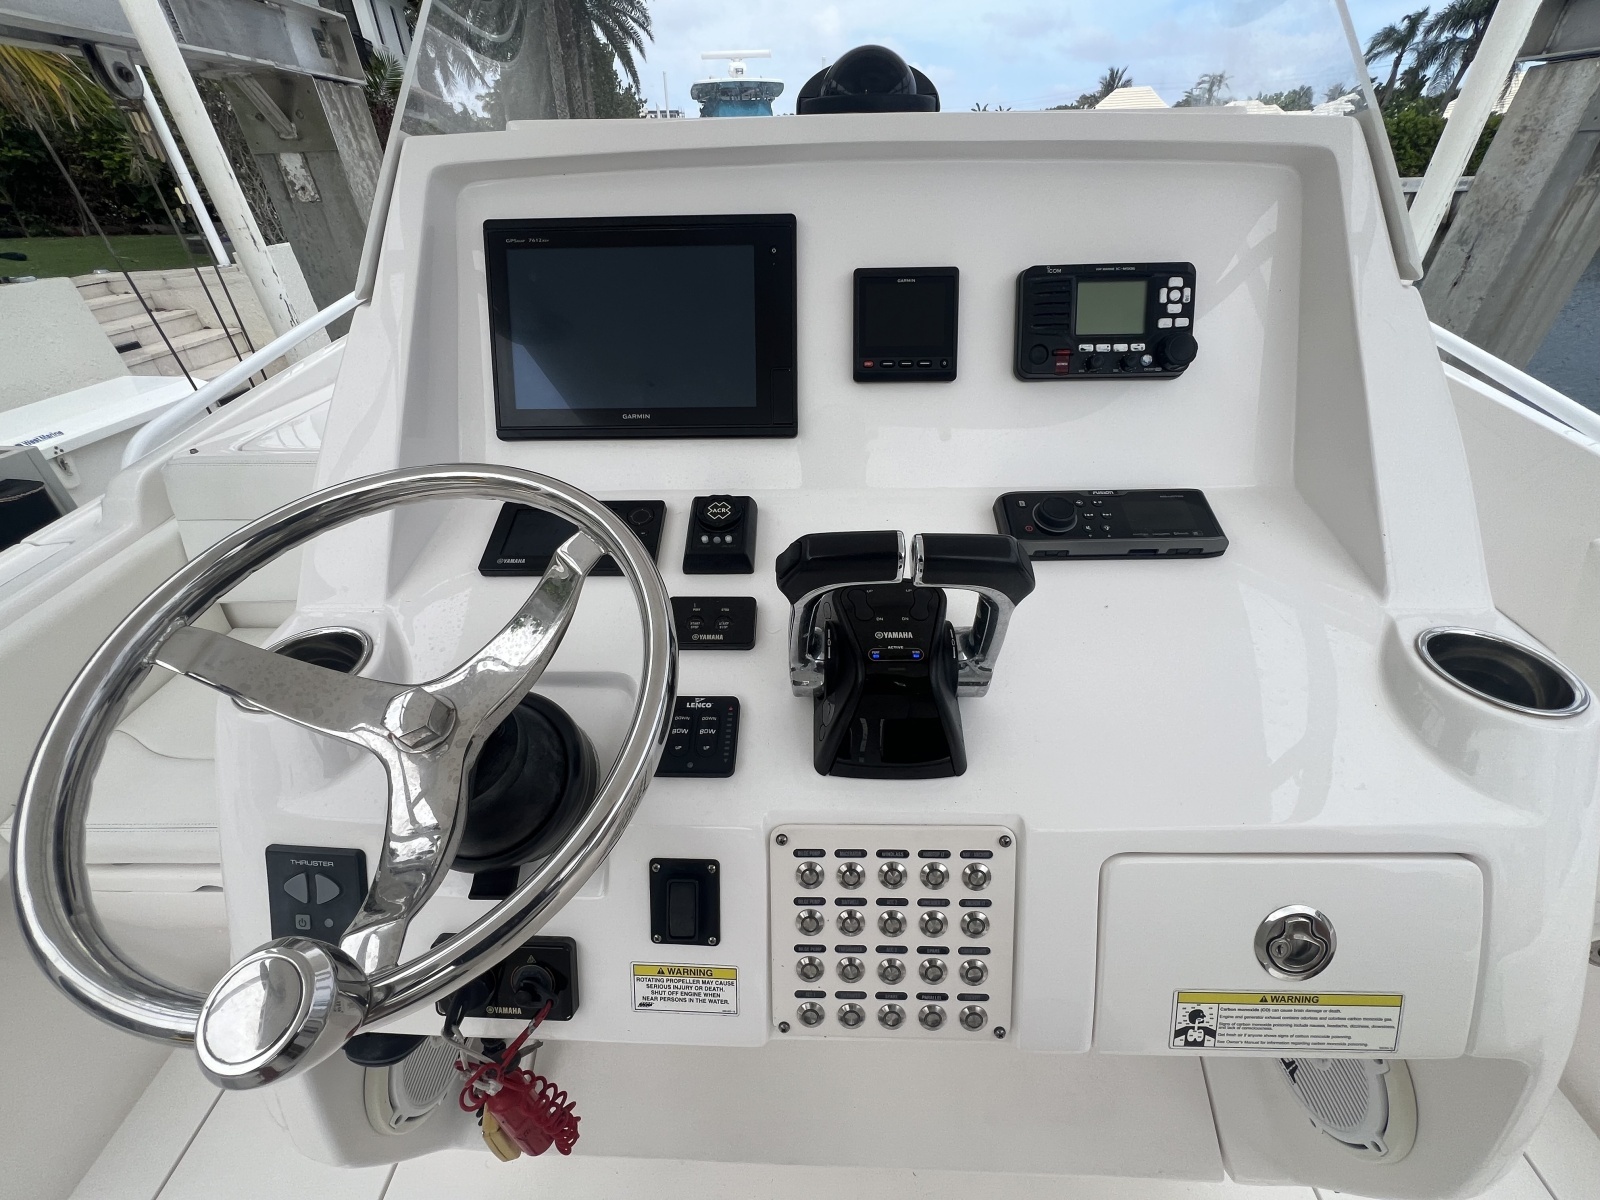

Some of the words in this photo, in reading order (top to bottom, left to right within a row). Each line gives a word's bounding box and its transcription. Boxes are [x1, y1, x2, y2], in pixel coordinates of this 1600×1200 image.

[38, 431, 64, 441] Marine
[883, 631, 913, 639] YAMAHA
[686, 702, 712, 710] LENCO
[290, 859, 334, 867] THRUSTER
[667, 967, 713, 977] WARNING
[1270, 995, 1319, 1004] WARNING
[494, 1006, 522, 1015] YAMAHA
